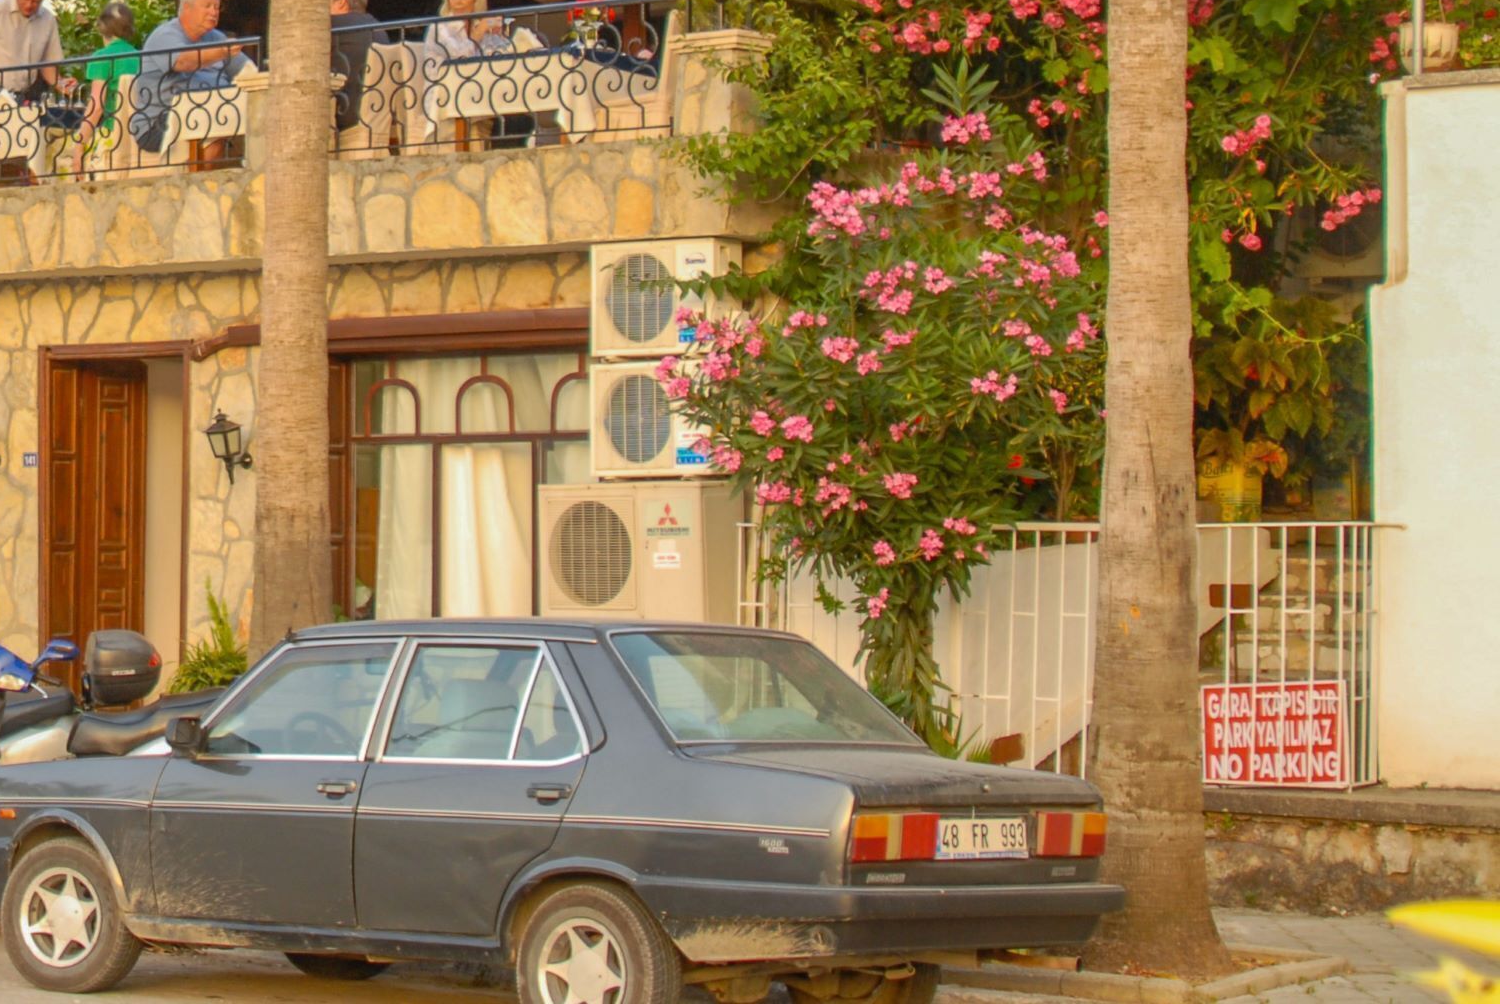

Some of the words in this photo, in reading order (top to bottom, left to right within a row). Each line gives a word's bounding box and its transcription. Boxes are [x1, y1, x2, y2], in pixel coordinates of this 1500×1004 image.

[1214, 721, 1251, 748] PARK
[1211, 753, 1243, 779] NO
[1251, 751, 1339, 779] PARKING
[942, 823, 959, 848] 48
[972, 823, 989, 848] FR
[1001, 822, 1024, 847] 993
